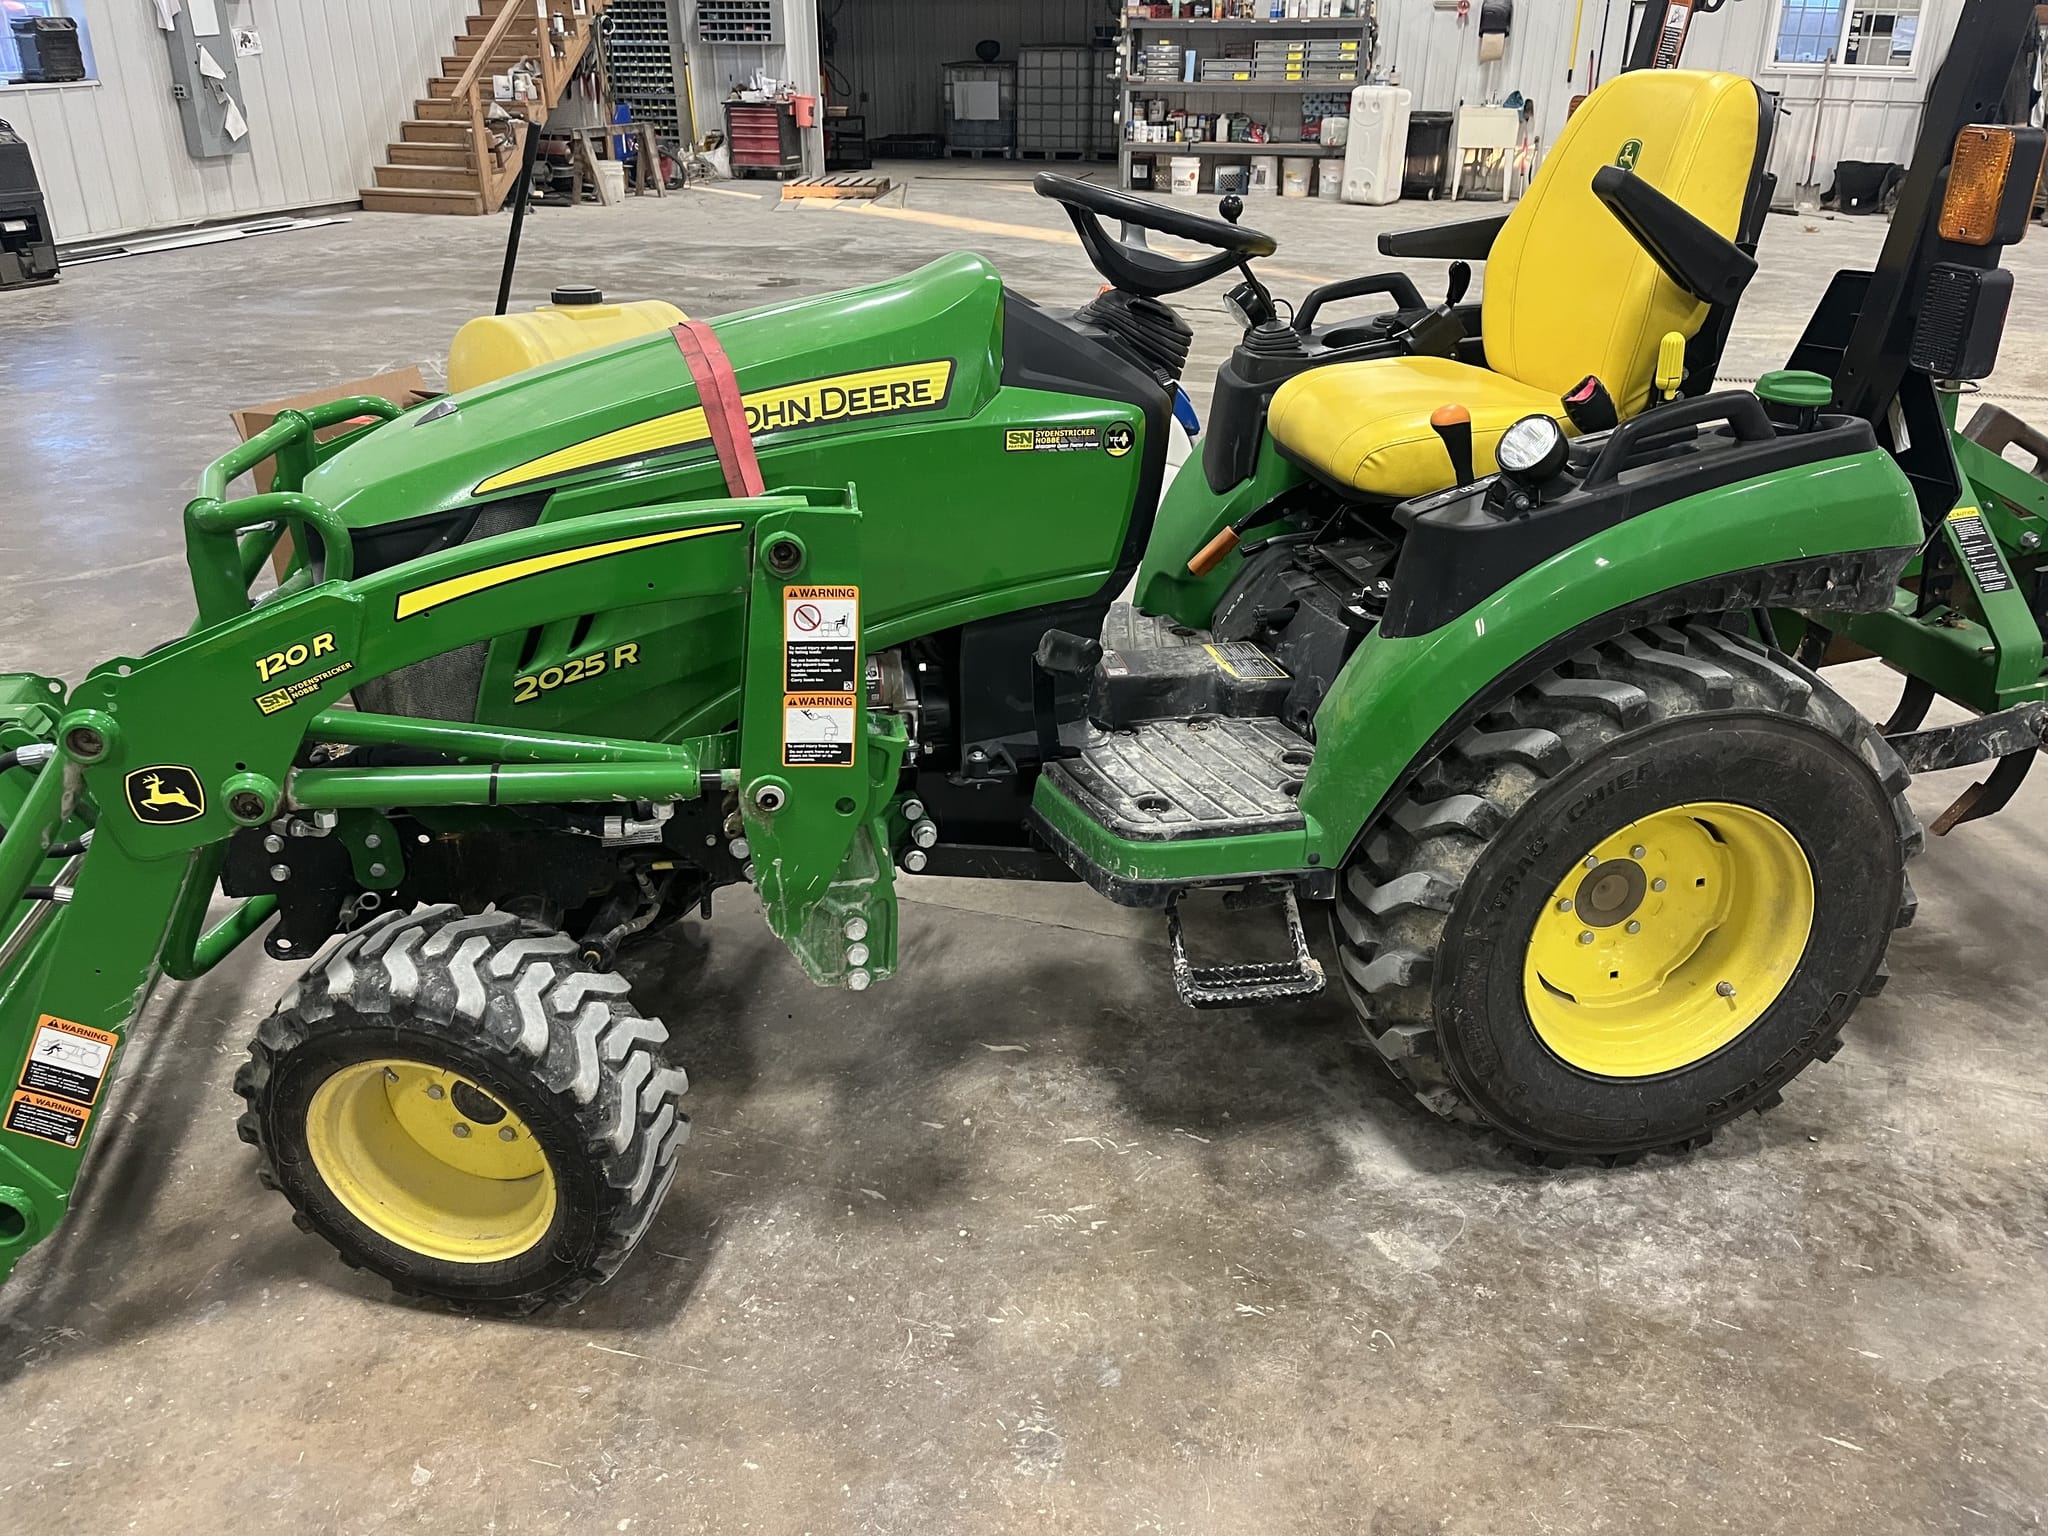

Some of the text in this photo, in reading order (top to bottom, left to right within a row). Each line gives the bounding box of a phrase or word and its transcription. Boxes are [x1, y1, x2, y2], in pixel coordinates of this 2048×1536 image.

[743, 378, 932, 428] OHN DEERE
[1008, 432, 1033, 444] SN
[1035, 428, 1096, 437] SYDENSTRICKER
[1035, 436, 1060, 444] NOBBE
[800, 587, 855, 598] WARNING
[255, 632, 335, 682] 120 R
[287, 662, 353, 693] SYDENSTRICKER
[513, 642, 638, 704] 2025 R
[259, 690, 289, 708] SN
[291, 683, 319, 700] NOBBE
[798, 697, 853, 706] WARNING
[61, 1023, 109, 1042] WARNING
[35, 1098, 82, 1116] WARNING
